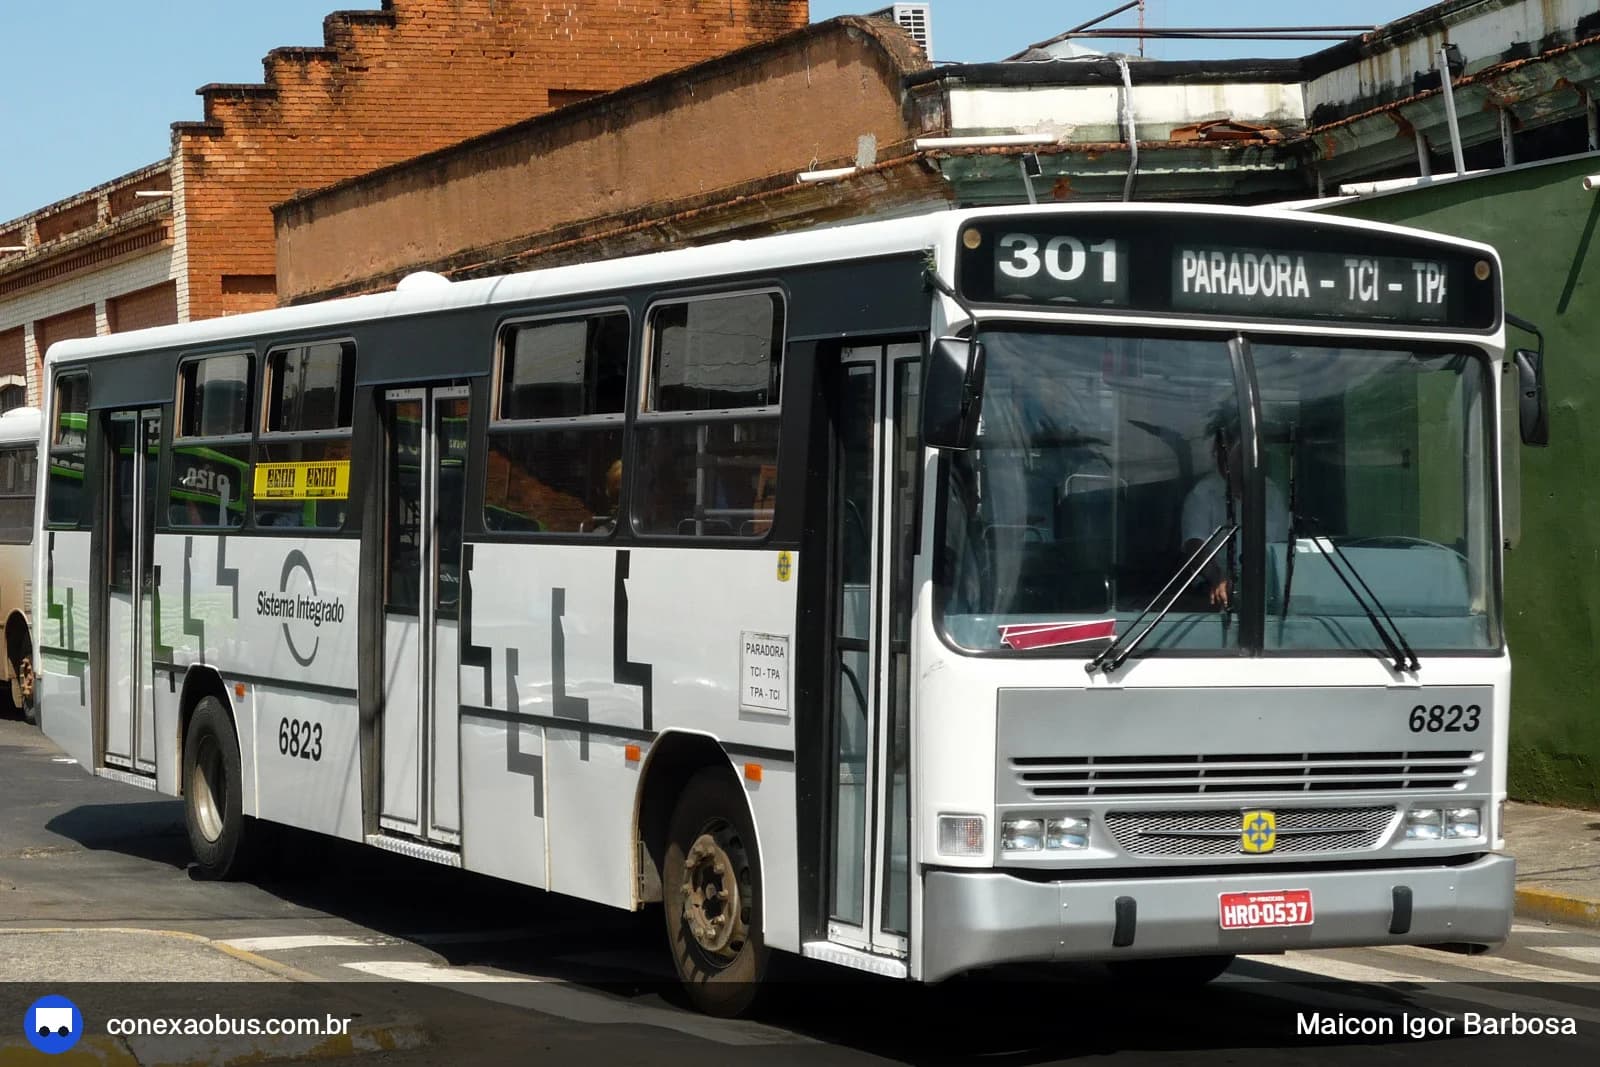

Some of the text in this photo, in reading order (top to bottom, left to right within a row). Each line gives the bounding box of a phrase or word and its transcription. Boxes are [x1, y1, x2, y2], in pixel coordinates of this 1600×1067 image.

[999, 232, 1117, 282] 301
[1181, 249, 1311, 298] PARADORA
[1345, 258, 1379, 303] TCI
[256, 590, 345, 627] Sistema Integrado
[745, 642, 785, 658] PARADORA
[750, 666, 762, 677] TCI
[767, 668, 781, 680] TPA
[750, 686, 764, 698] TPA
[769, 689, 781, 700] TCI
[1408, 704, 1482, 733] 6823
[278, 716, 323, 762] 6823
